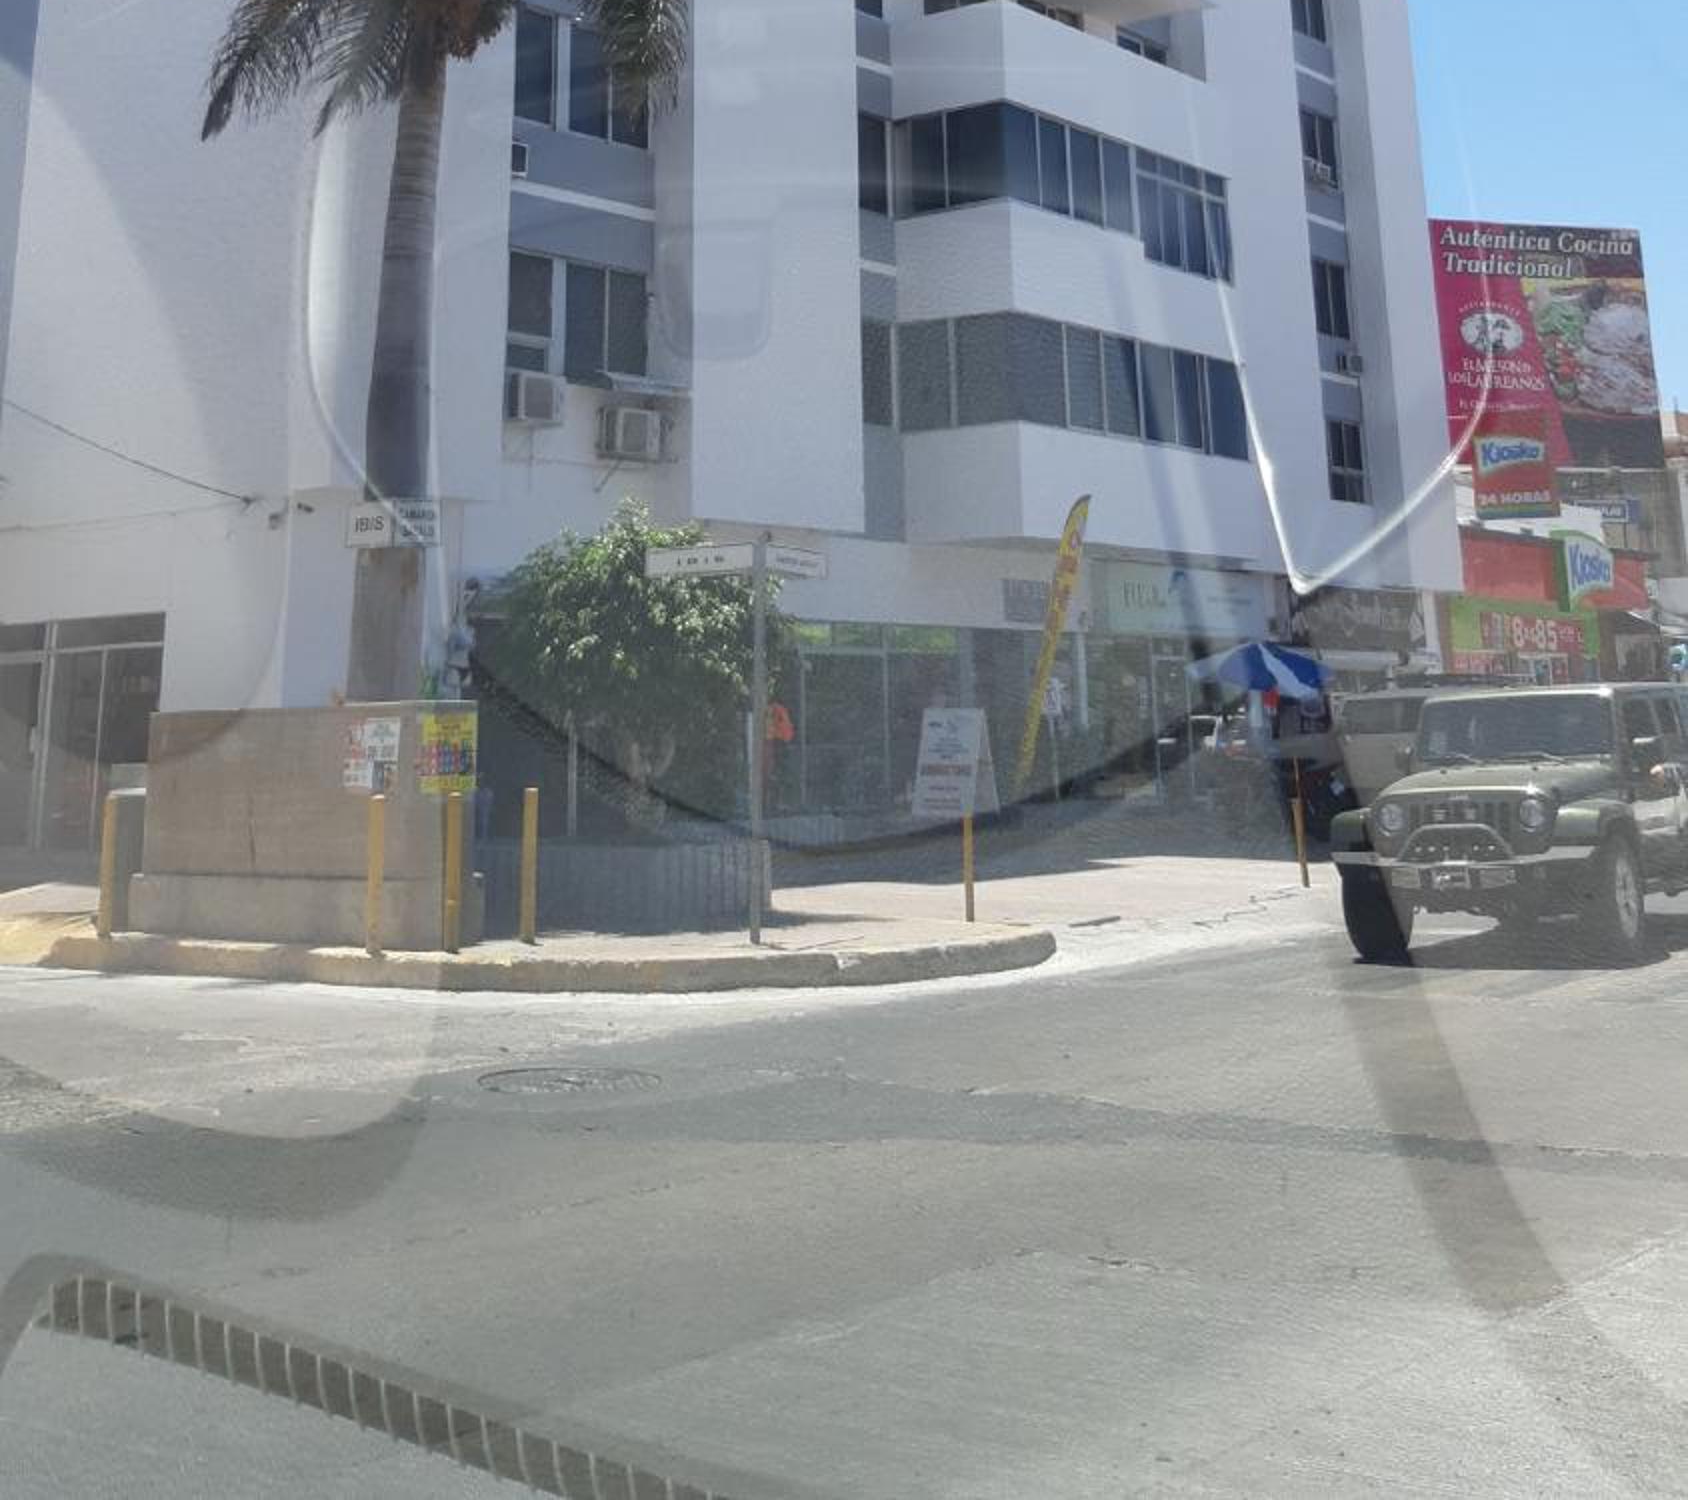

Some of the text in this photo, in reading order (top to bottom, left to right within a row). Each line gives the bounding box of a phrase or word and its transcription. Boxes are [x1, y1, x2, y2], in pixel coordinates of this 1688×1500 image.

[1558, 232, 1633, 255] Cocina
[1444, 252, 1573, 278] Tradicional
[1501, 489, 1550, 504] HORAS
[355, 515, 385, 533] IBIS
